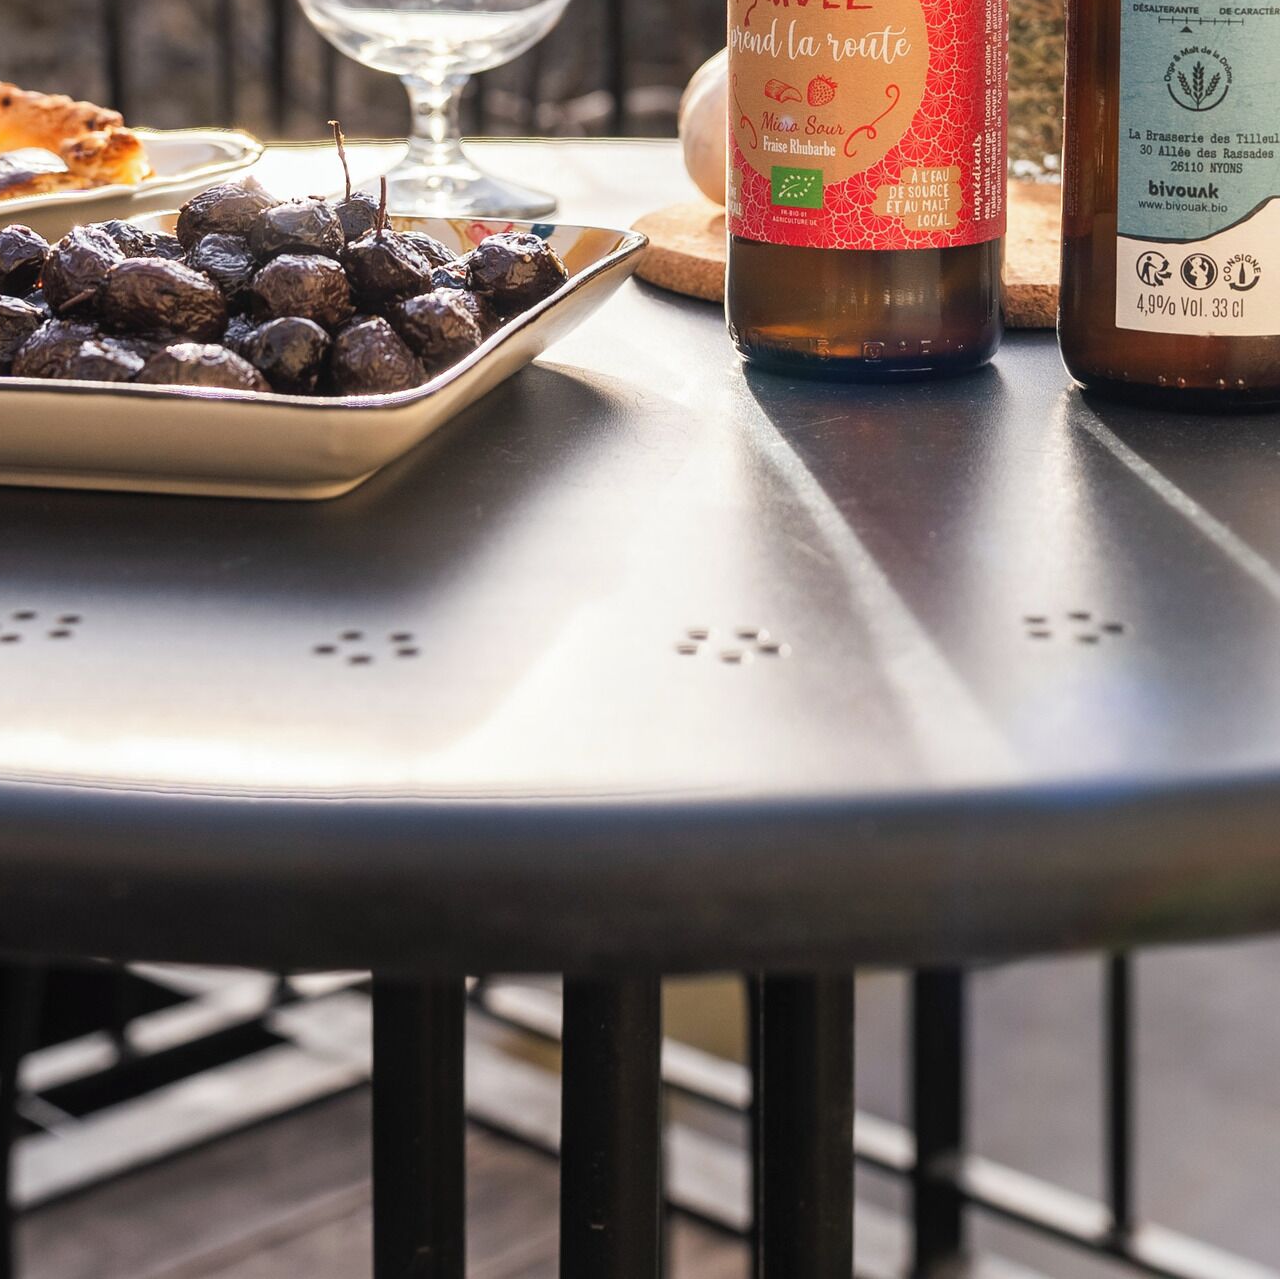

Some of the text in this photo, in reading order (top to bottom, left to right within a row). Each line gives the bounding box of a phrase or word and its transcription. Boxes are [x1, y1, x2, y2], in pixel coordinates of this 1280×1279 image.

[1219, 7, 1233, 15] DE
[730, 18, 911, 65] prend la route
[1163, 62, 1175, 82] Orge
[1180, 45, 1199, 57] Malt
[1200, 46, 1212, 55] de
[1212, 49, 1220, 59] la
[761, 111, 846, 136] Micro Sour
[1128, 128, 1141, 140] La
[1146, 129, 1204, 144] Brasserie
[1210, 133, 1230, 144] des
[763, 135, 836, 157] Fraise Rhubarbe
[1139, 144, 1274, 159] 30 Allée des Rassades
[911, 168, 949, 183] À L'EAU
[1170, 161, 1243, 174] 26110 NYONS
[972, 133, 983, 221] ingrédients
[889, 183, 949, 199] DE SOURCE
[1148, 180, 1220, 199] bivouak
[886, 198, 951, 215] ET AU MALT
[1138, 200, 1228, 213] www.bivouak.bio
[772, 215, 809, 226] AGRICULTURE
[917, 214, 951, 228] LOCAL
[1223, 254, 1261, 282] CONSIGNE
[1136, 293, 1244, 318] 4,9% Vol. 33 cl
